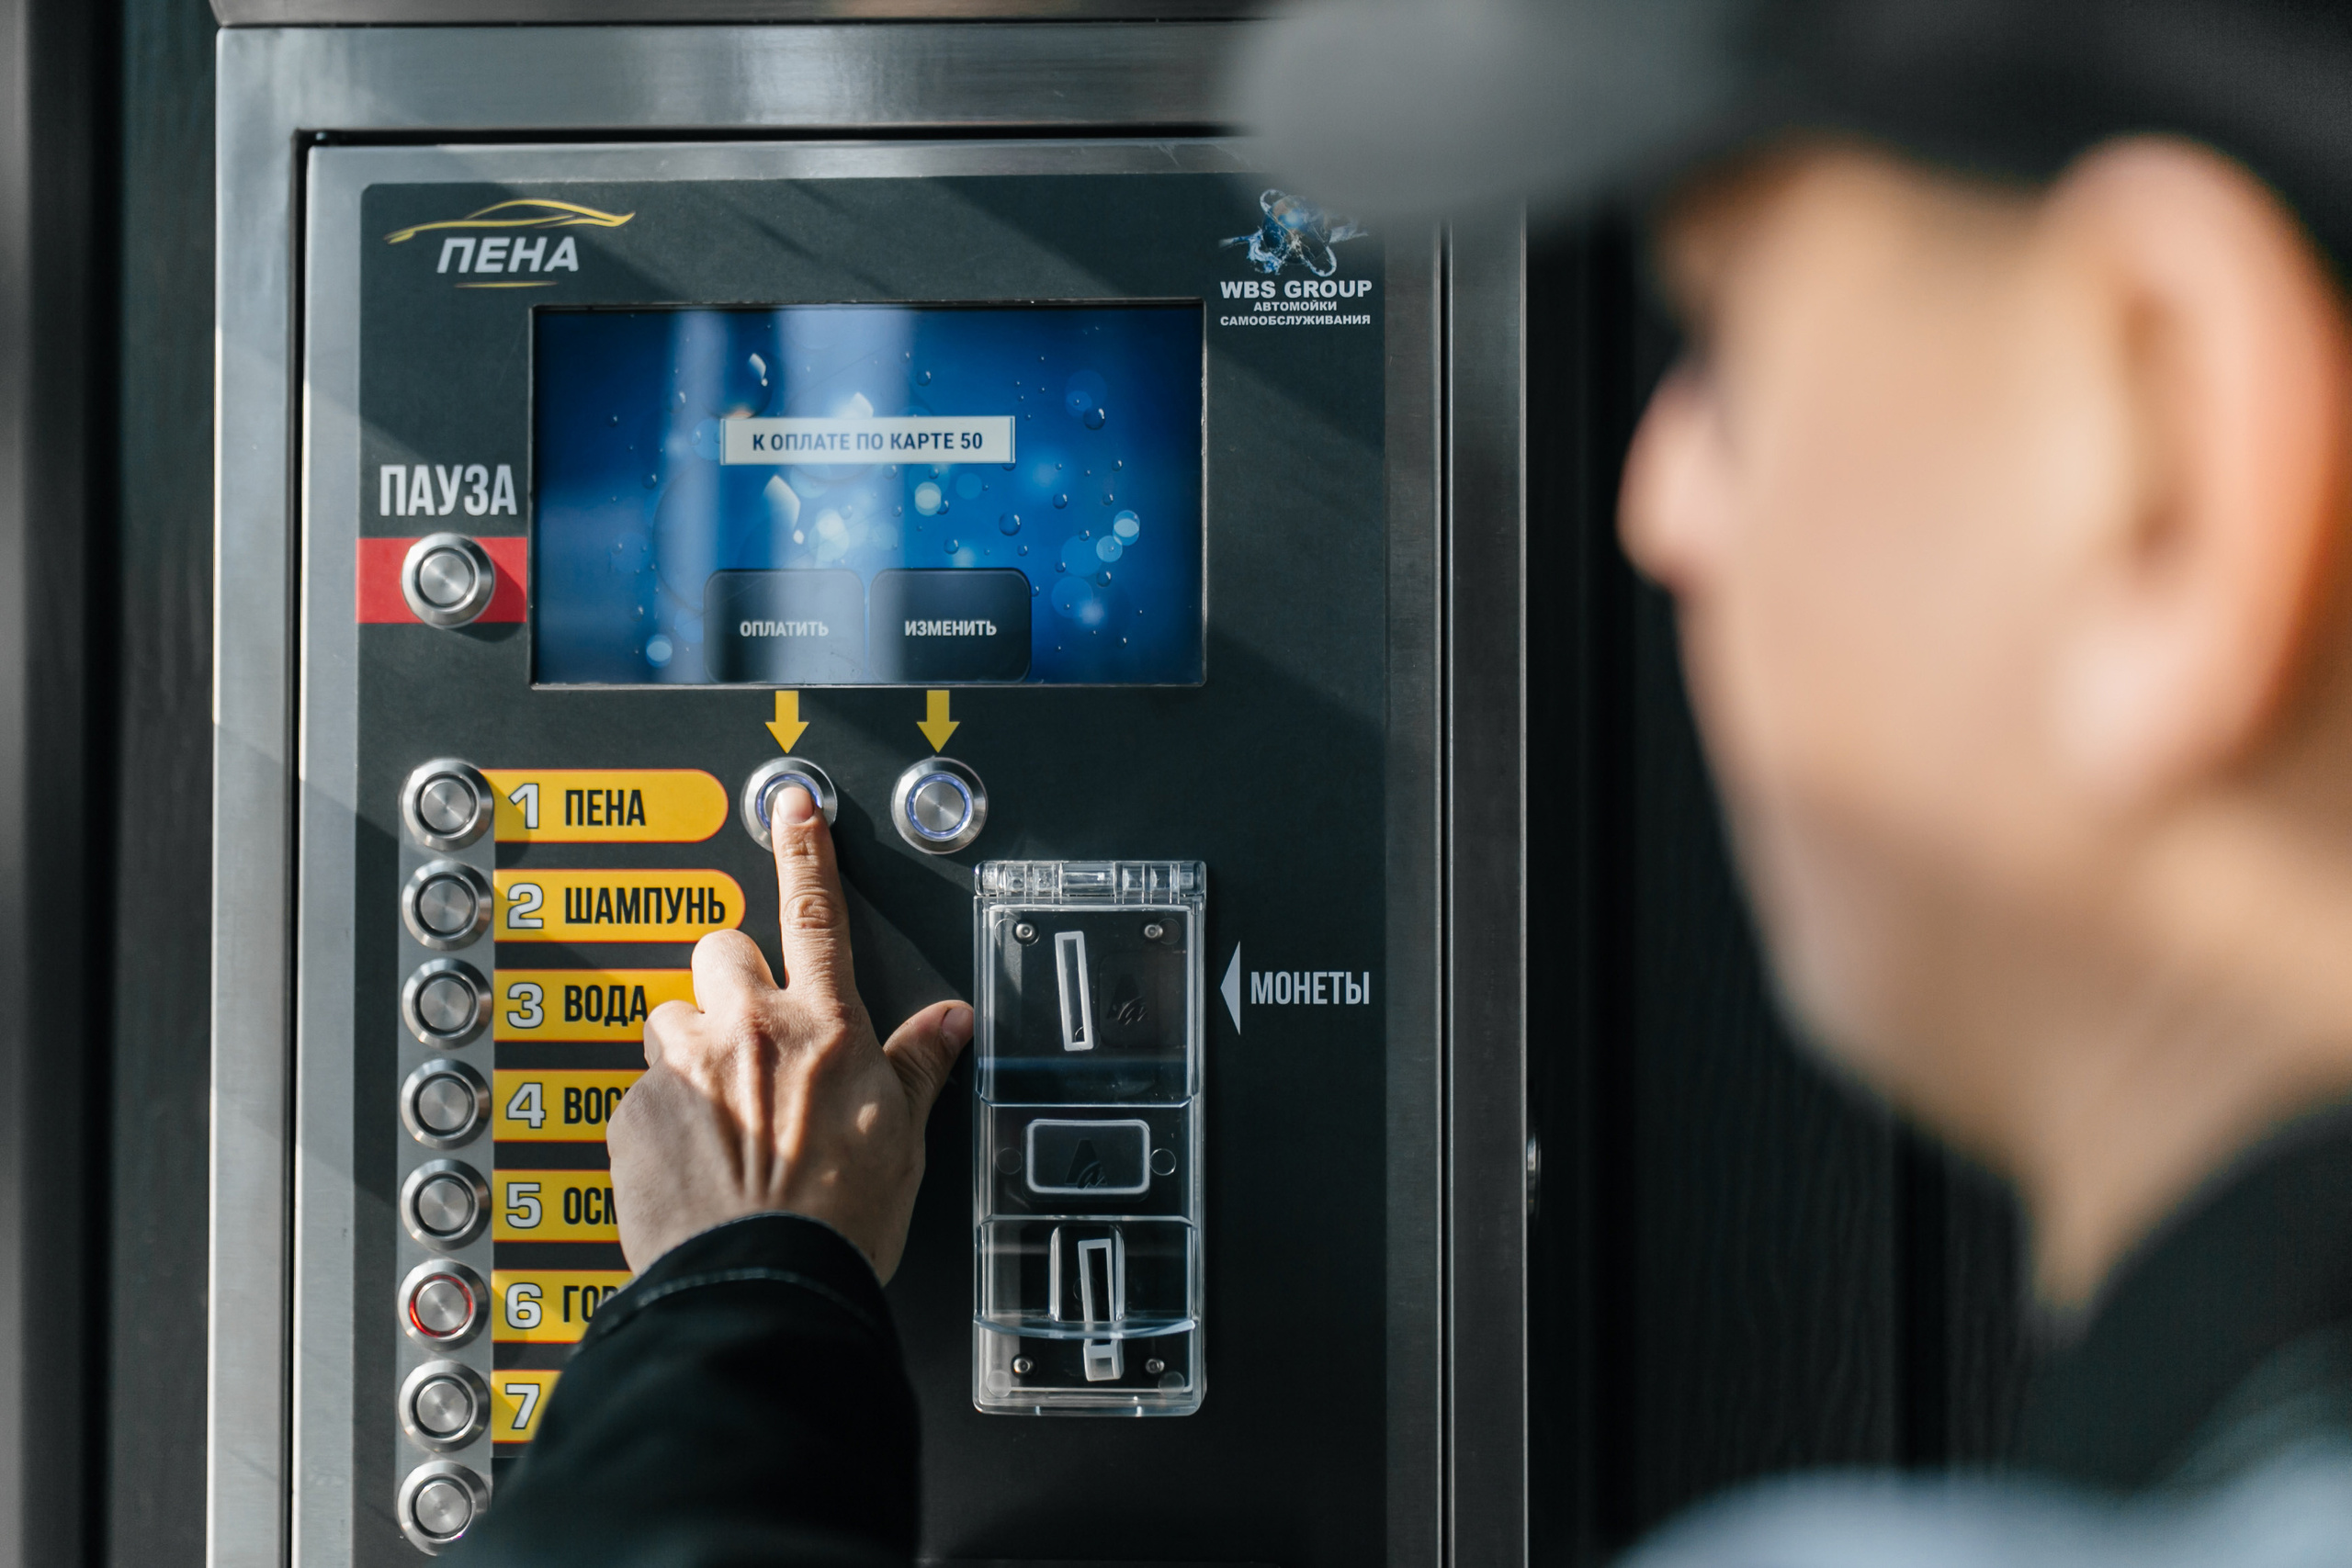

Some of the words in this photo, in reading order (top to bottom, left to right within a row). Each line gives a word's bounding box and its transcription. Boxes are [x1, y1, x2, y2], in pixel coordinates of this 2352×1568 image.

[436, 236, 579, 274] ПЕНА
[1219, 281, 1276, 299] WBS
[1283, 280, 1373, 299] GROUP
[1253, 299, 1337, 312] АВТОМОЙКИ
[1220, 314, 1371, 326] САМООБСЛУЖИВАНИЯ
[752, 434, 765, 451] К
[770, 433, 851, 451] ОПЛАТЕ
[856, 433, 884, 451] ПО
[890, 432, 955, 450] КАРТЕ
[960, 432, 983, 449] 50
[379, 463, 517, 516] ПАУЗА
[740, 619, 830, 637] ОПЛАТИТЬ
[904, 619, 998, 637] ИЗМЕНИТЬ
[508, 783, 540, 829] 1
[564, 789, 647, 826] ПЕНА
[506, 883, 544, 930] 2
[564, 886, 726, 924] ШАМПУНЬ
[506, 982, 545, 1029] 3
[564, 985, 648, 1027] ВОДА
[1250, 971, 1370, 1005] МОНЕТЫ
[505, 1082, 546, 1129] 4
[563, 1087, 631, 1125] ВОС
[505, 1182, 542, 1229] 5
[505, 1282, 543, 1329] 6
[505, 1383, 541, 1430] 7
